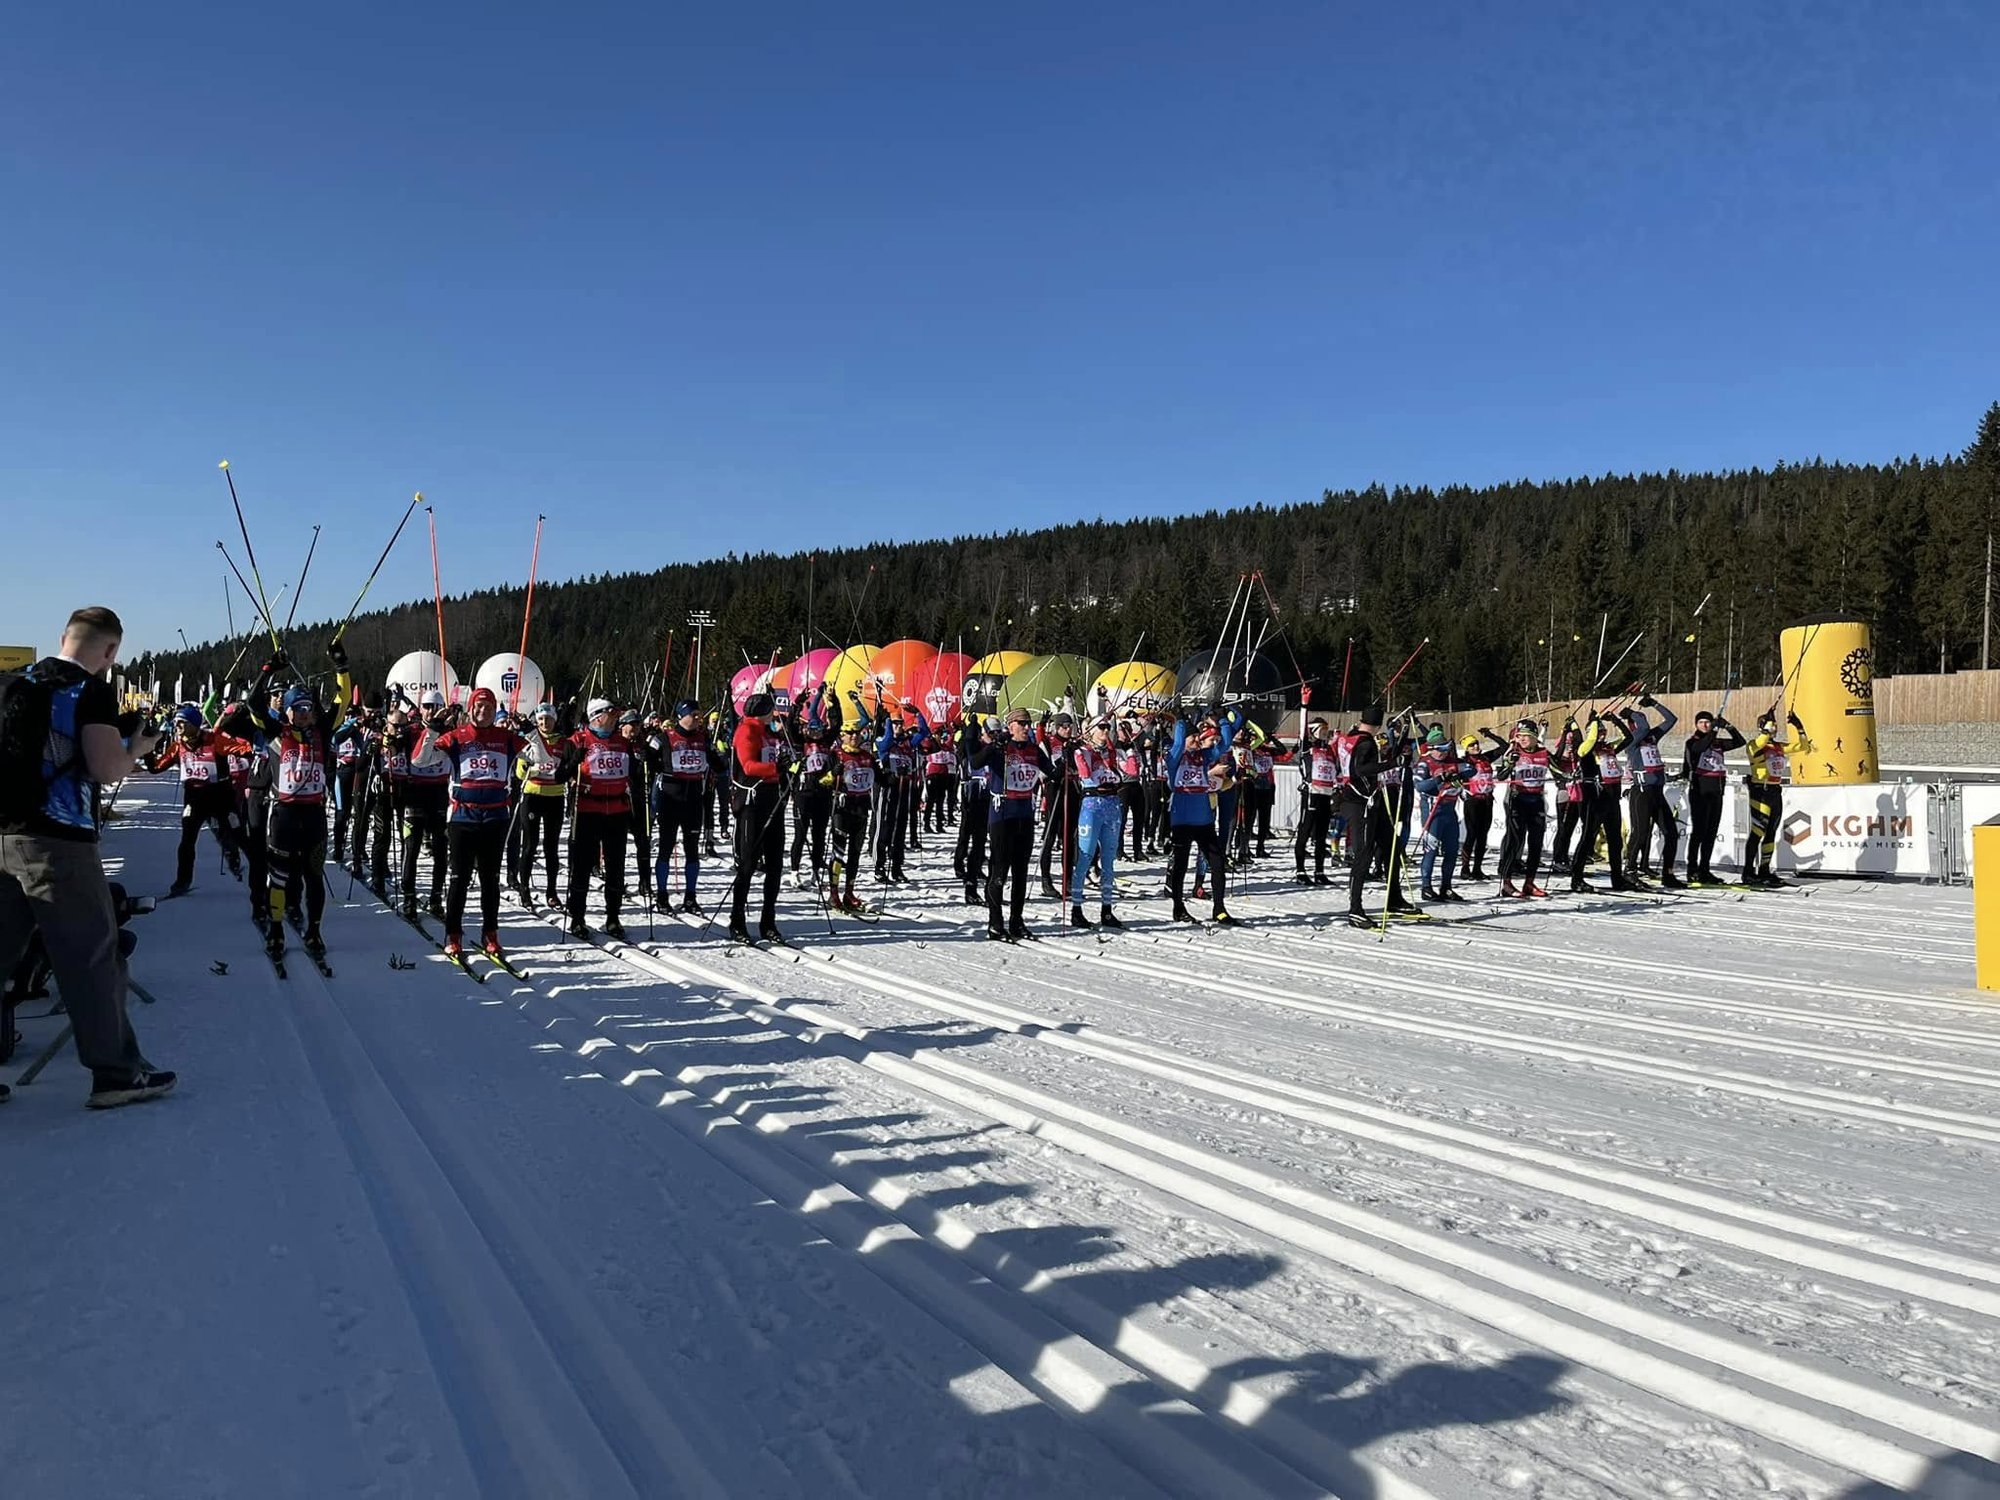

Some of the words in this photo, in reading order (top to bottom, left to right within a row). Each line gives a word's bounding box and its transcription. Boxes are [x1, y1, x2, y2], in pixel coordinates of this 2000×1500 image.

[401, 682, 438, 691] KGHM
[469, 758, 498, 771] 894
[597, 757, 622, 769] 868
[185, 767, 209, 778] 949
[1822, 815, 1913, 837] KGHM
